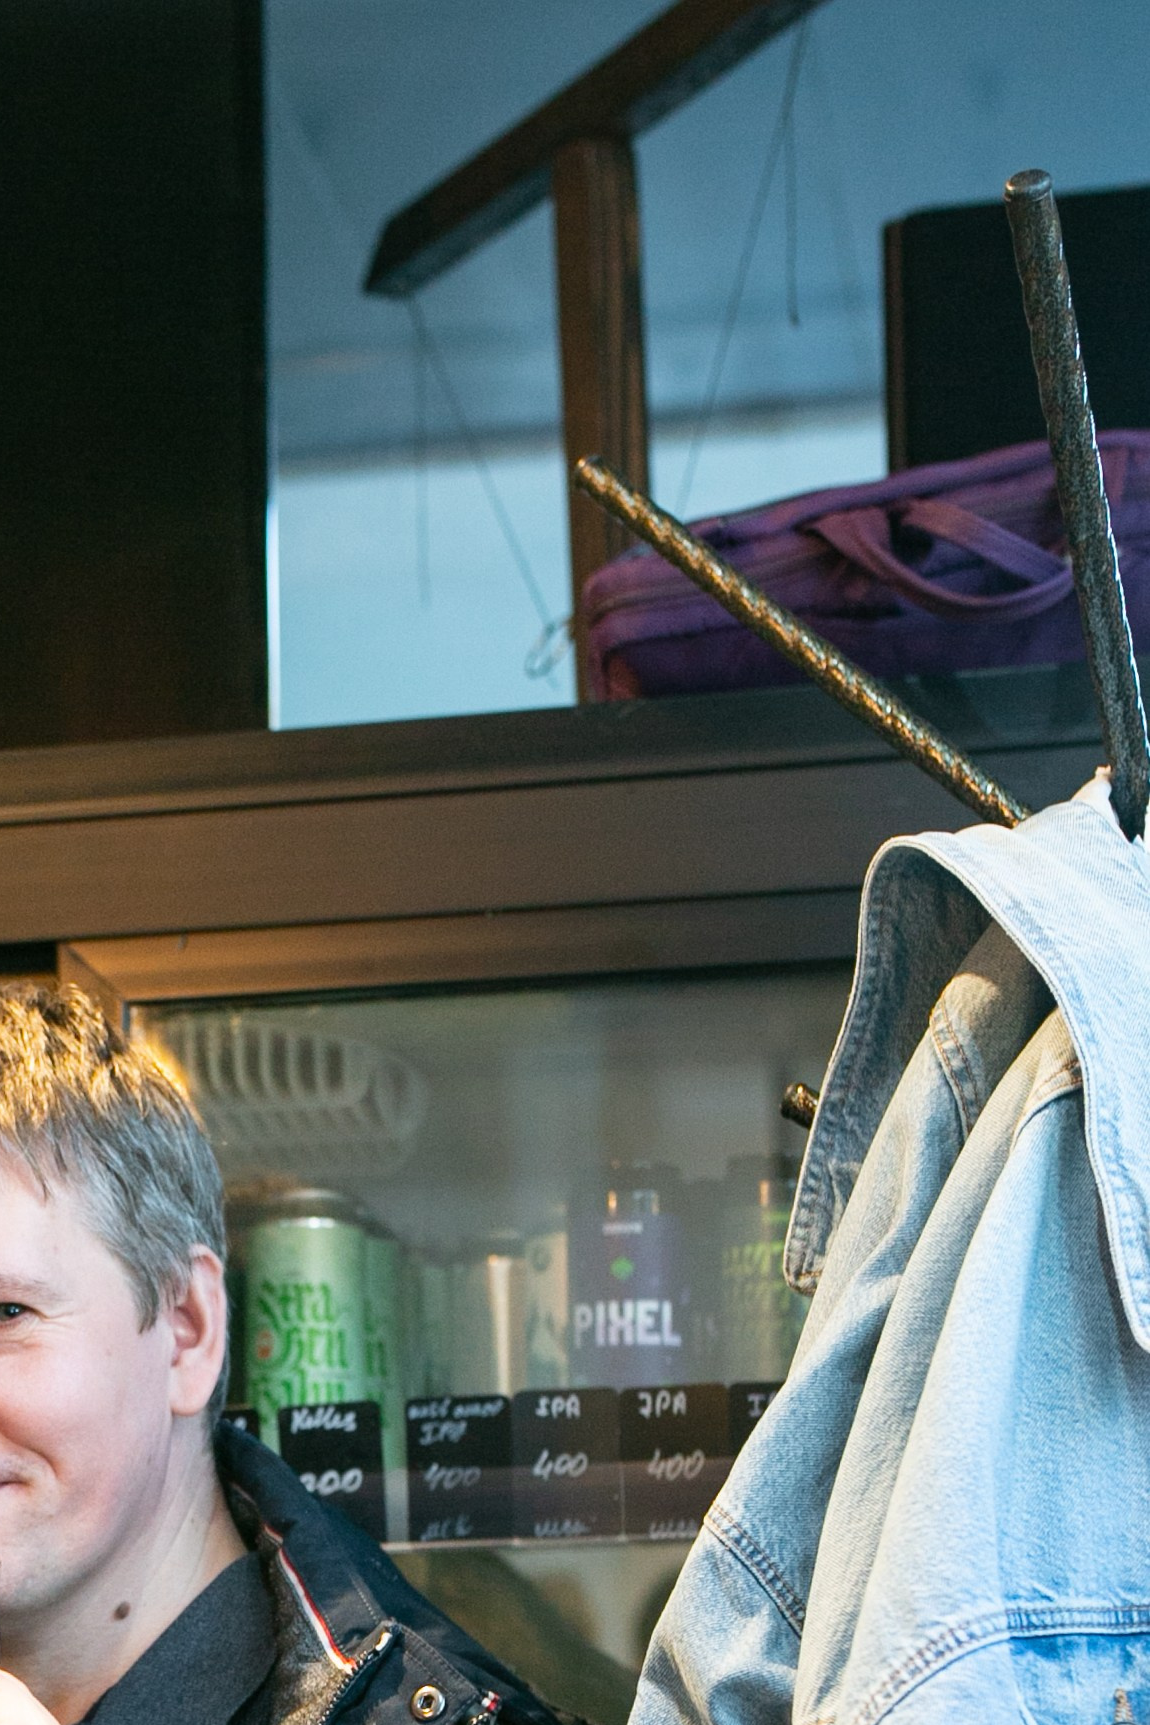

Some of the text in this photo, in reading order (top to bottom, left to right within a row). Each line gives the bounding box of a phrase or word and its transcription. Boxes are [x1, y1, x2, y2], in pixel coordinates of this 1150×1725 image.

[574, 1299, 682, 1348] PIXEL
[535, 1394, 581, 1419] IPA
[638, 1390, 687, 1418] IPA
[424, 1462, 481, 1491] 400
[533, 1449, 588, 1480] 400
[648, 1449, 705, 1481] 400
